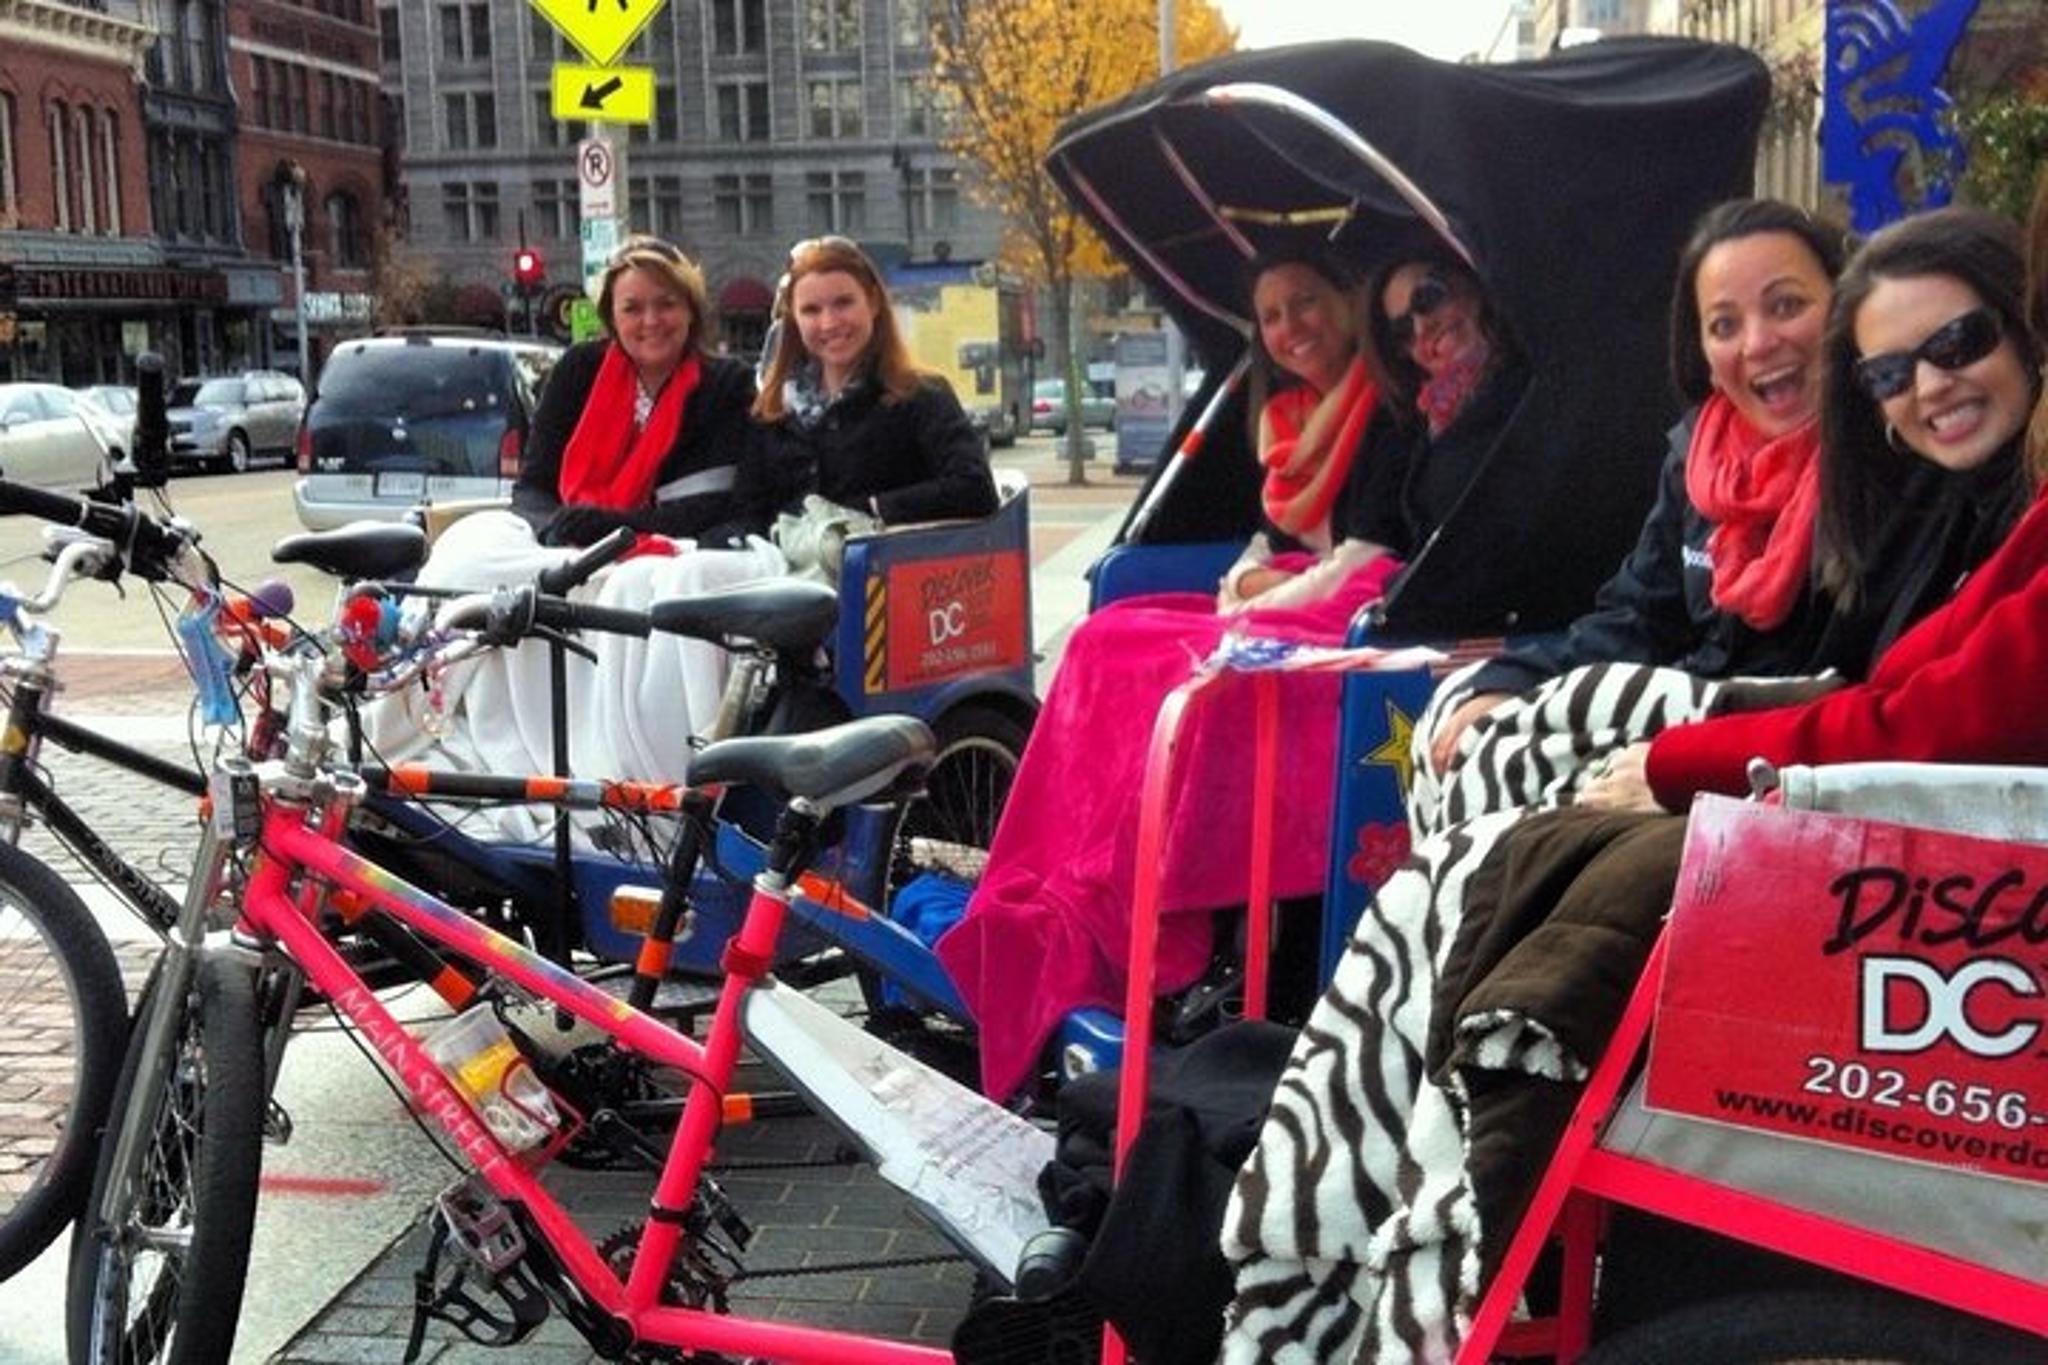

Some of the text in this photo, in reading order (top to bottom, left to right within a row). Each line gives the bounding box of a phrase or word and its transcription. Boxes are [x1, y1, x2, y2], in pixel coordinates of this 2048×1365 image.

[929, 601, 966, 646] DC
[1861, 953, 2043, 1060] DC
[337, 987, 499, 1173] MAIN STREET
